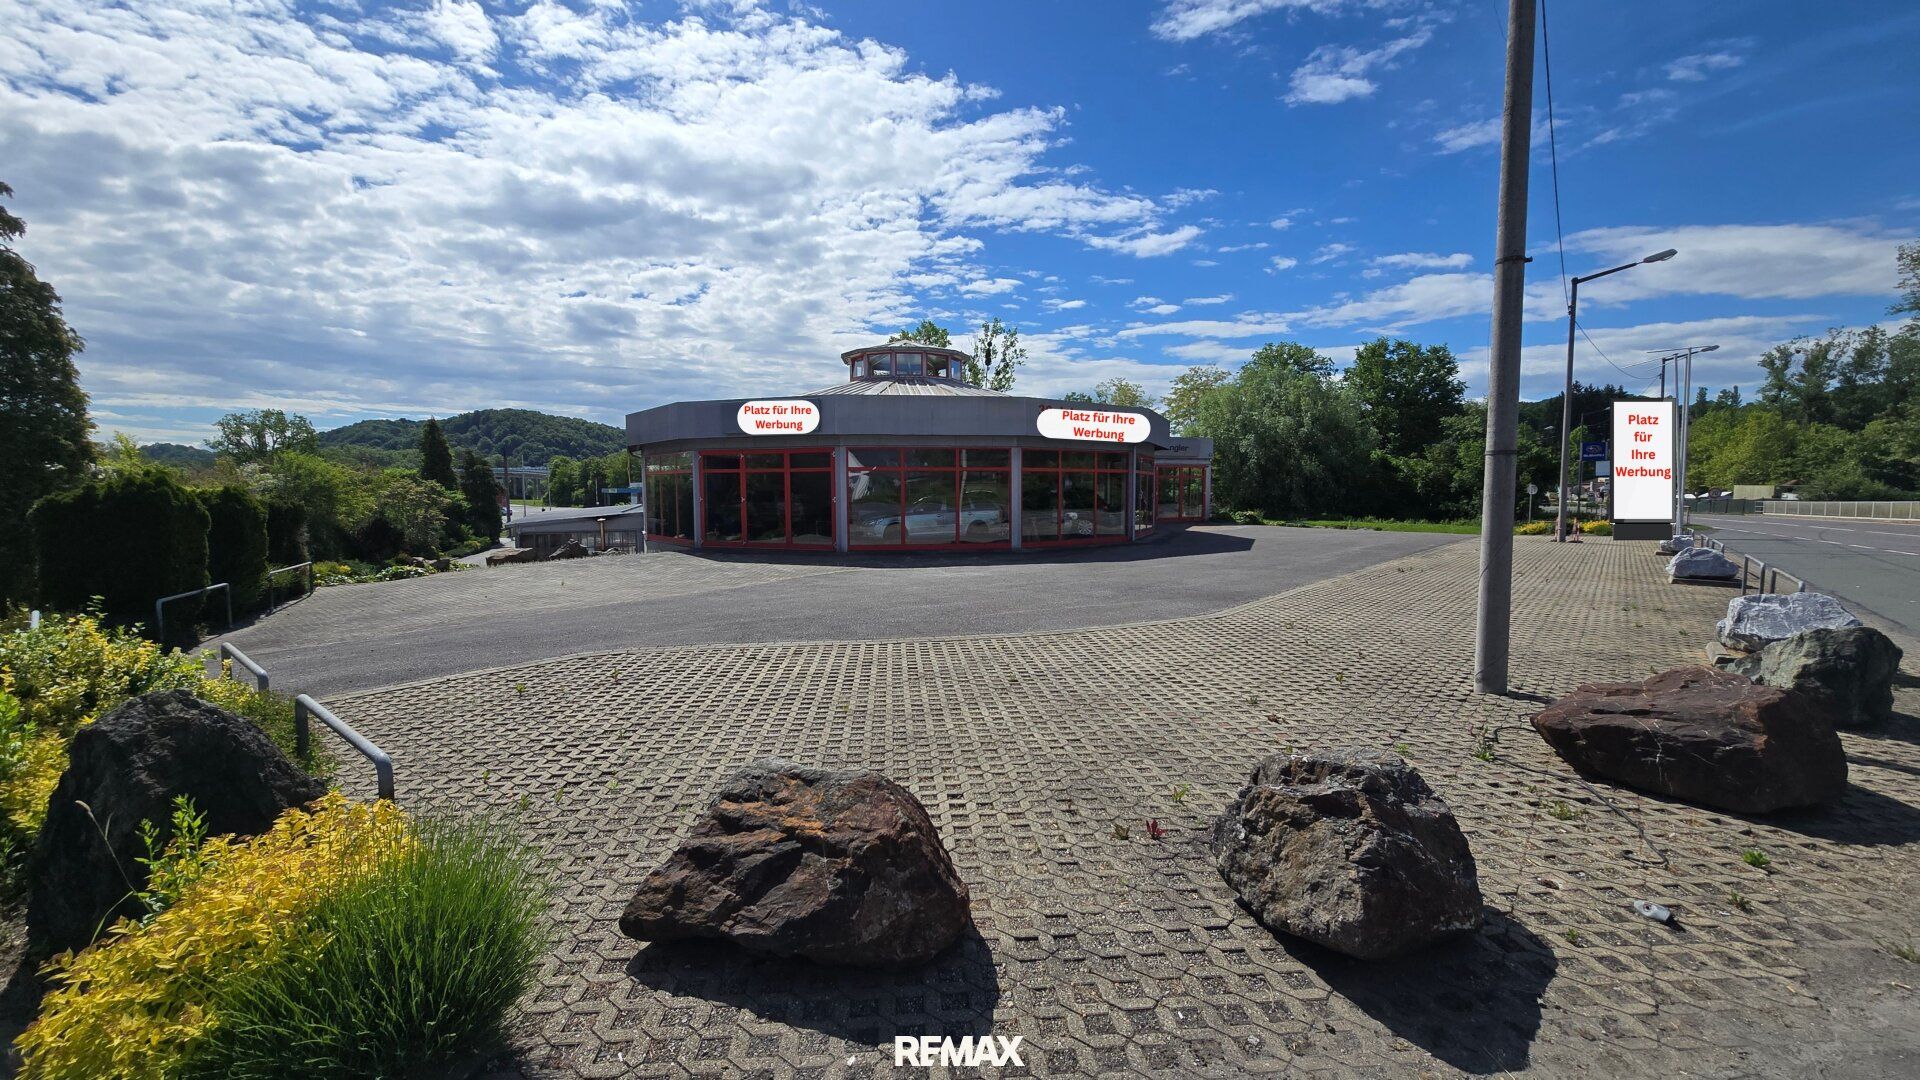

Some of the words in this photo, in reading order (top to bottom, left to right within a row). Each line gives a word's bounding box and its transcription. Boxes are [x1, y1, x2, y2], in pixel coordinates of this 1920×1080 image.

[744, 405, 770, 415] Platz
[772, 405, 788, 415] für
[791, 405, 812, 415] Ihre
[1062, 410, 1091, 422] Platz
[1093, 412, 1110, 423] für
[1112, 414, 1135, 425] Ihre
[1628, 414, 1659, 425] Platz
[755, 420, 803, 431] Werbung
[1073, 427, 1125, 443] Werbung
[1634, 431, 1652, 442] für
[1169, 444, 1189, 453] ngler
[1631, 449, 1656, 460] Ihre
[1615, 466, 1671, 480] Werbung
